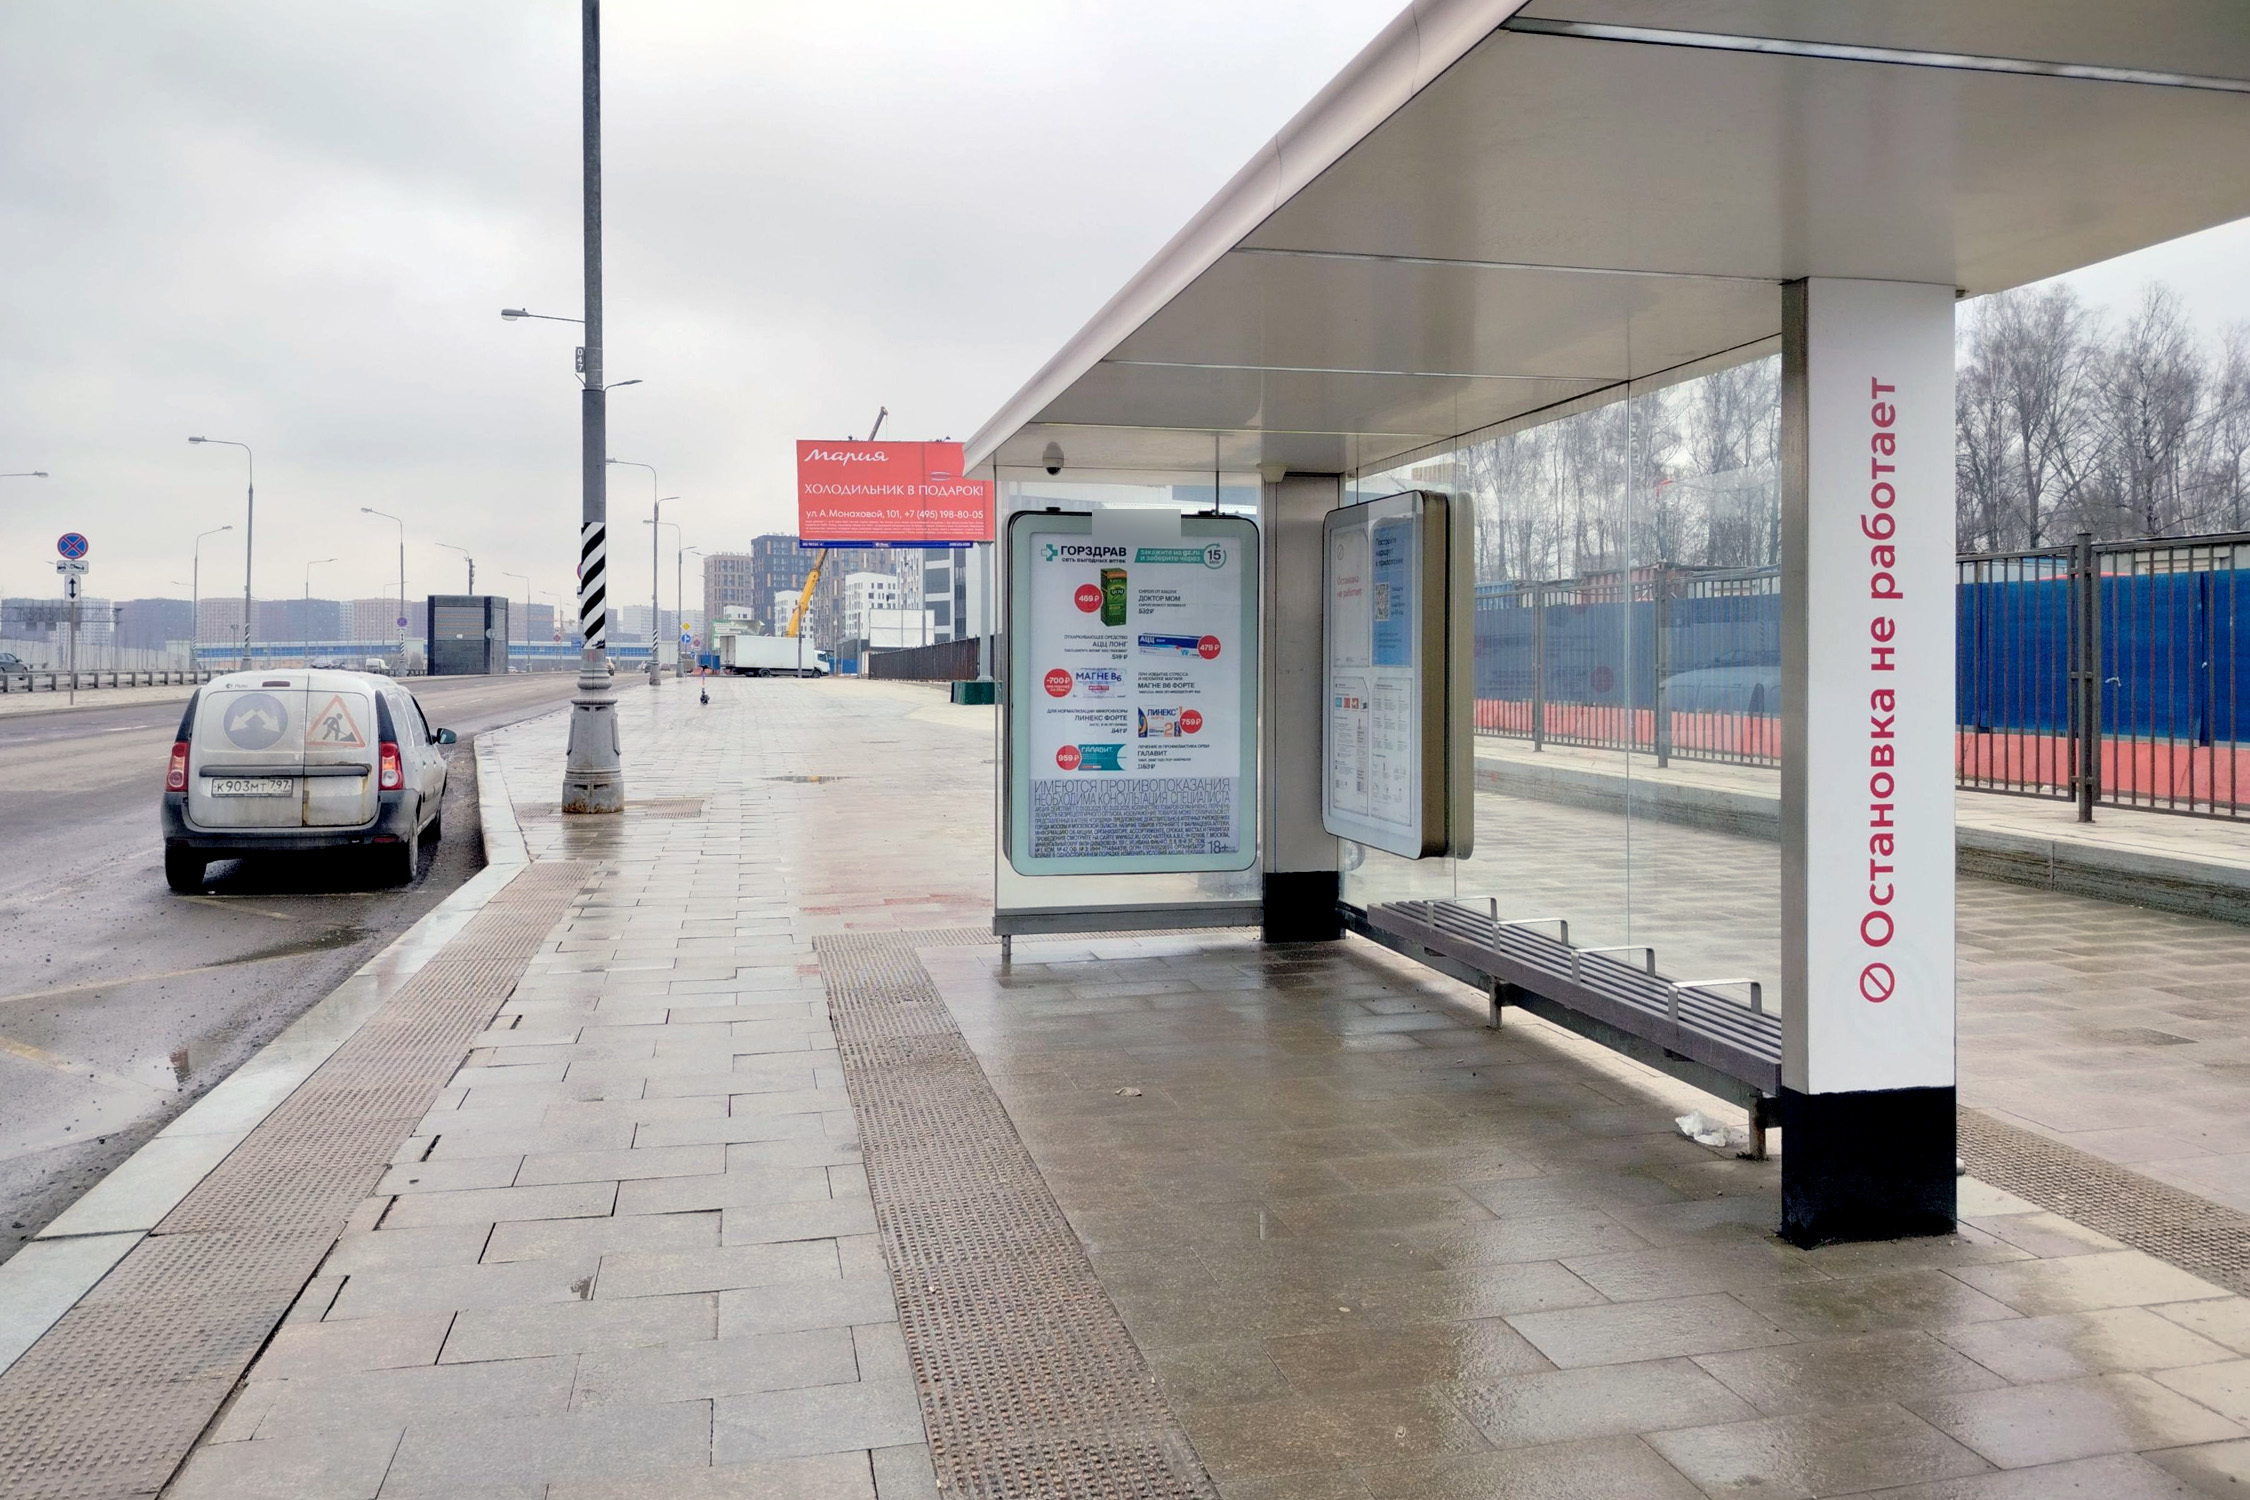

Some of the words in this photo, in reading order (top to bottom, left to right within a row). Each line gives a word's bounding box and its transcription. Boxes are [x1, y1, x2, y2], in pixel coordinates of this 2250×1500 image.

[804, 449, 889, 467] Мария
[804, 483, 904, 496] ХОЛОДИЛЬНИК
[907, 485, 915, 495] В
[919, 485, 984, 497] ПОДАРОК!
[1859, 376, 1903, 600] работает
[904, 510, 915, 519] +7
[916, 510, 938, 520] (495)
[939, 510, 984, 519] 198-80-05
[1060, 545, 1127, 558] ГОРЗДРАВ
[1207, 549, 1222, 561] 15
[1870, 615, 1895, 672] не
[1075, 672, 1109, 681] МАГНЕ
[1147, 707, 1177, 716] ЛИНЕКС
[1081, 746, 1113, 754] ГАЛАВИТ
[1034, 779, 1098, 794] ИМЕЮТСЯ
[1100, 777, 1231, 793] ПРОТИВОПОКАЗАНИЯ
[1034, 792, 1097, 806] НЕОБХОДИМА
[1098, 790, 1168, 806] КОНСУЛЬТАЦИЯ
[1170, 789, 1231, 805] СПЕЦИАЛИСТА
[1860, 689, 1895, 948] Остановка
[1206, 839, 1229, 855] 18+
